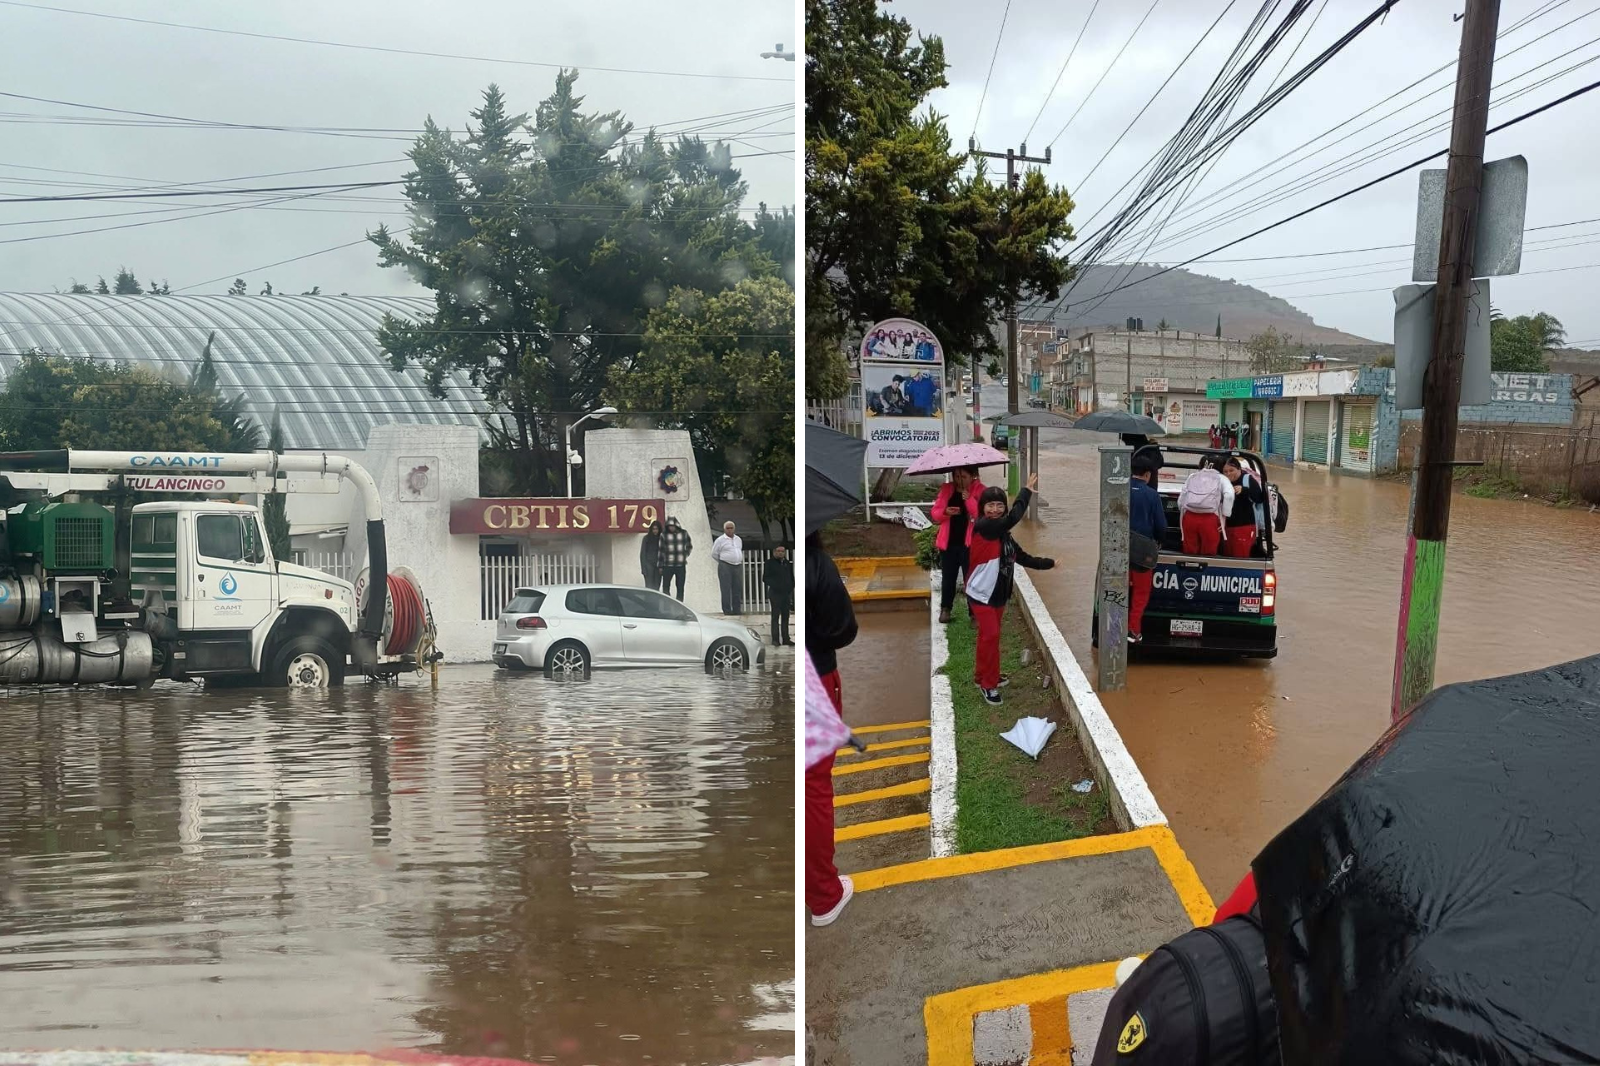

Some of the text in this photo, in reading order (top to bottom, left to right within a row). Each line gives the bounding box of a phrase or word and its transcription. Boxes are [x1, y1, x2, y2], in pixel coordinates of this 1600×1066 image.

[1491, 391, 1558, 402] RGAS
[129, 456, 224, 467] CAAMT
[126, 477, 226, 490] TULANCINGO
[483, 505, 657, 529] CBTIS 179
[1152, 569, 1262, 593] CÍA MUNICIPAL
